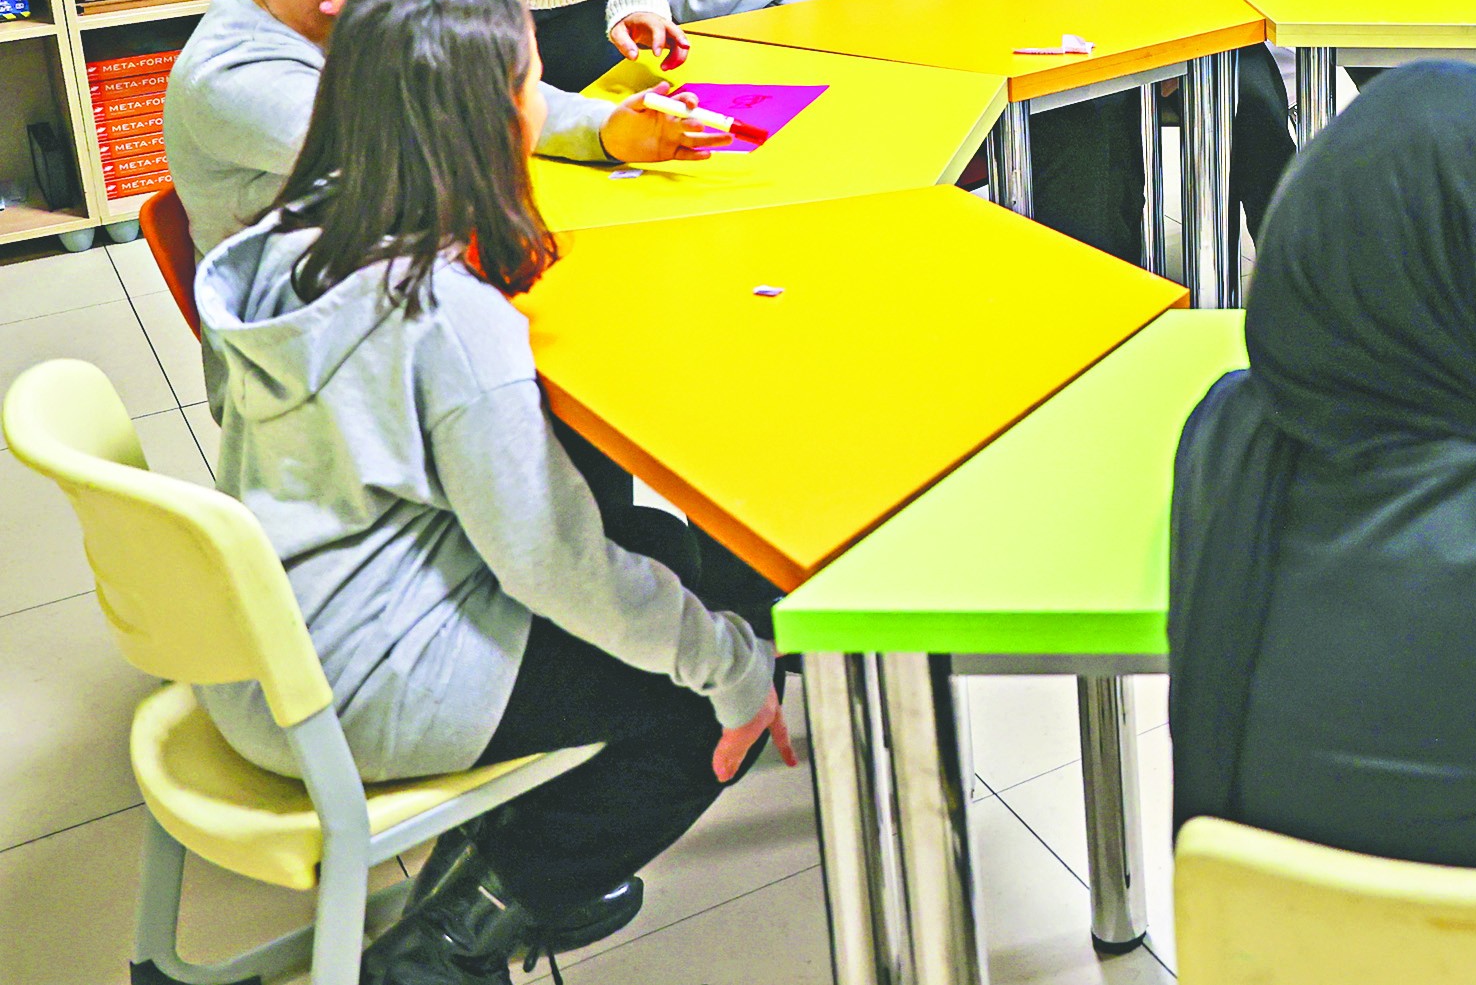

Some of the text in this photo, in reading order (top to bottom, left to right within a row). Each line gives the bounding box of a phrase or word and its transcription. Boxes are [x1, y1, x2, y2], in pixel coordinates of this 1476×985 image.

[104, 76, 171, 92] META-FOR
[111, 117, 164, 132] META-FO
[115, 137, 164, 152] META-FO
[119, 155, 168, 170] META-FO
[121, 174, 173, 190] META-FO
